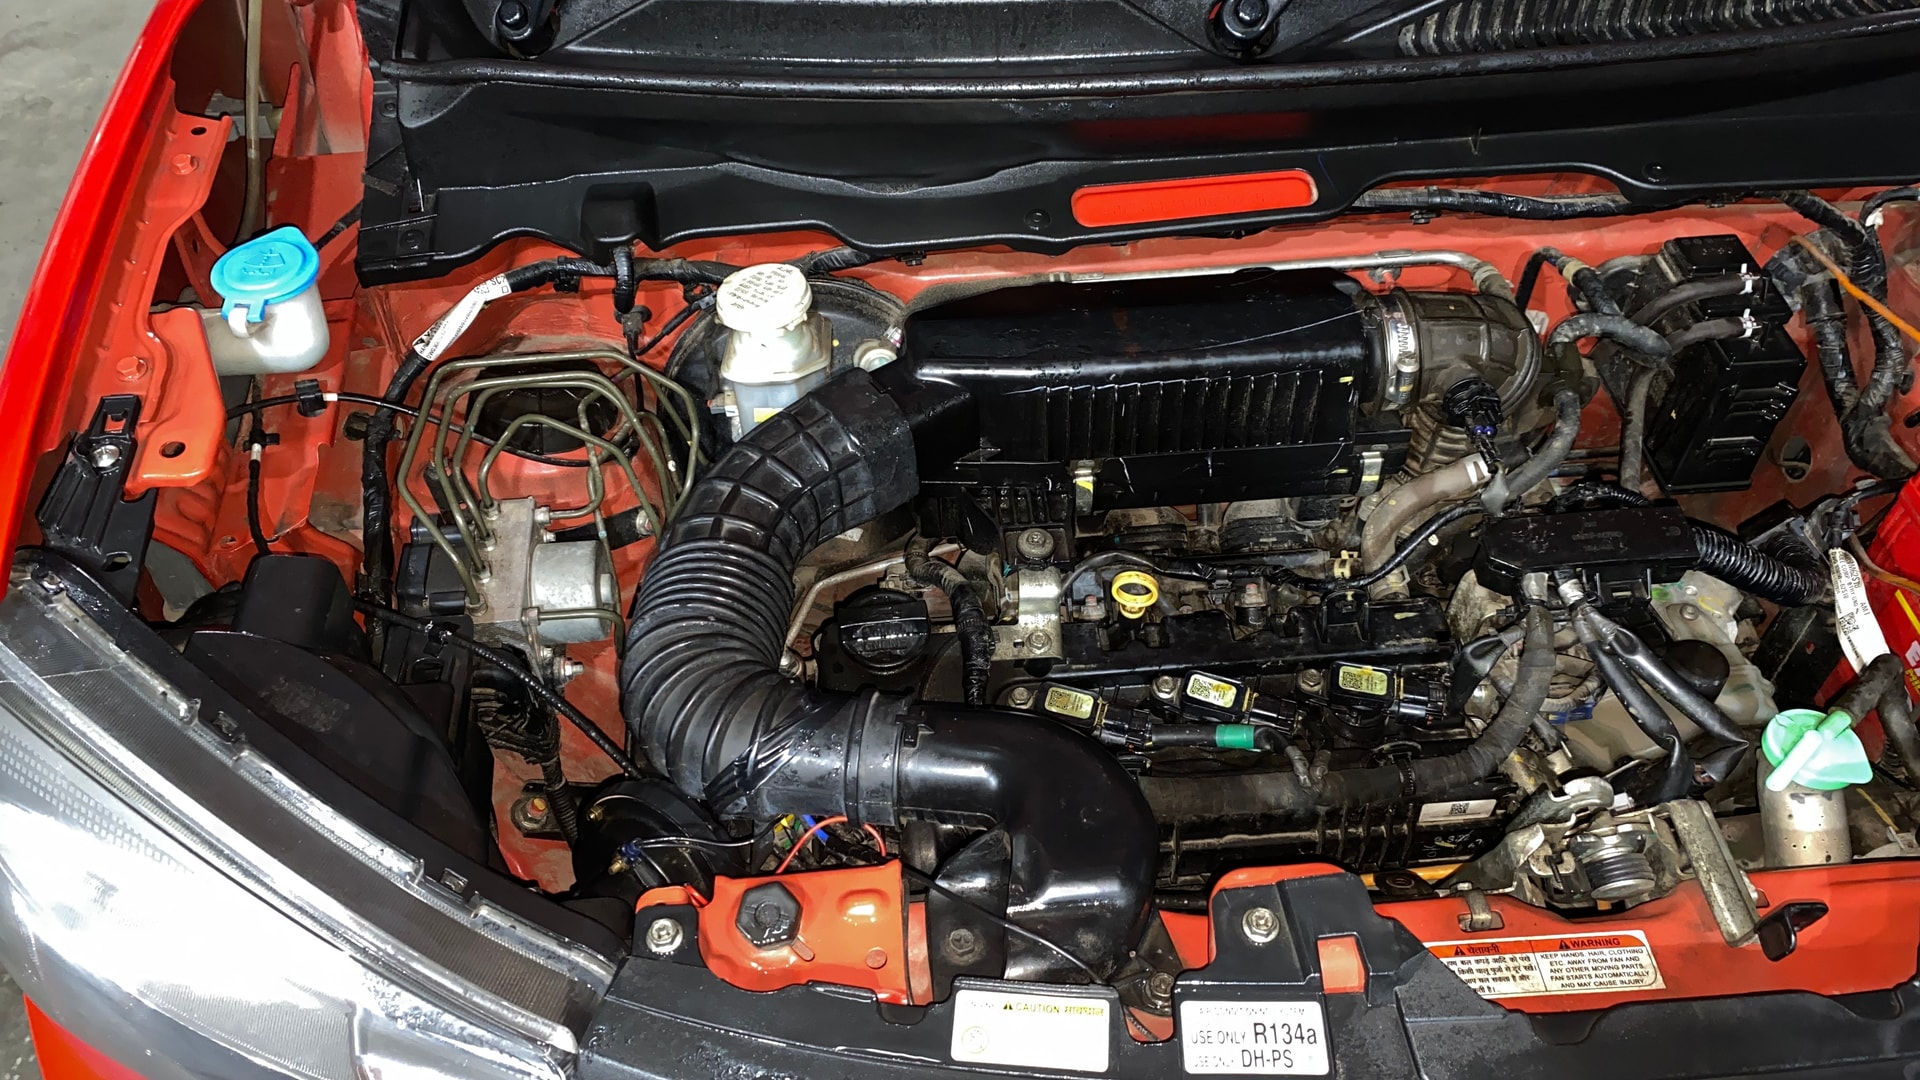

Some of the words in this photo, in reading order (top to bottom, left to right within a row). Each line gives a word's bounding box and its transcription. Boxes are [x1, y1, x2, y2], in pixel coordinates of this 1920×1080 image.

[1570, 937, 1621, 948] WARNING
[1467, 943, 1500, 954] चेतावनी
[1608, 948, 1644, 956] CLOTHING
[1594, 970, 1650, 979] AUTOMATICALLY
[1016, 1003, 1060, 1014] CAUTION
[1191, 1030, 1214, 1044] USE
[1216, 1030, 1247, 1044] ONLY
[1253, 1022, 1317, 1045] R134a
[1241, 1049, 1294, 1068] DH-PS
